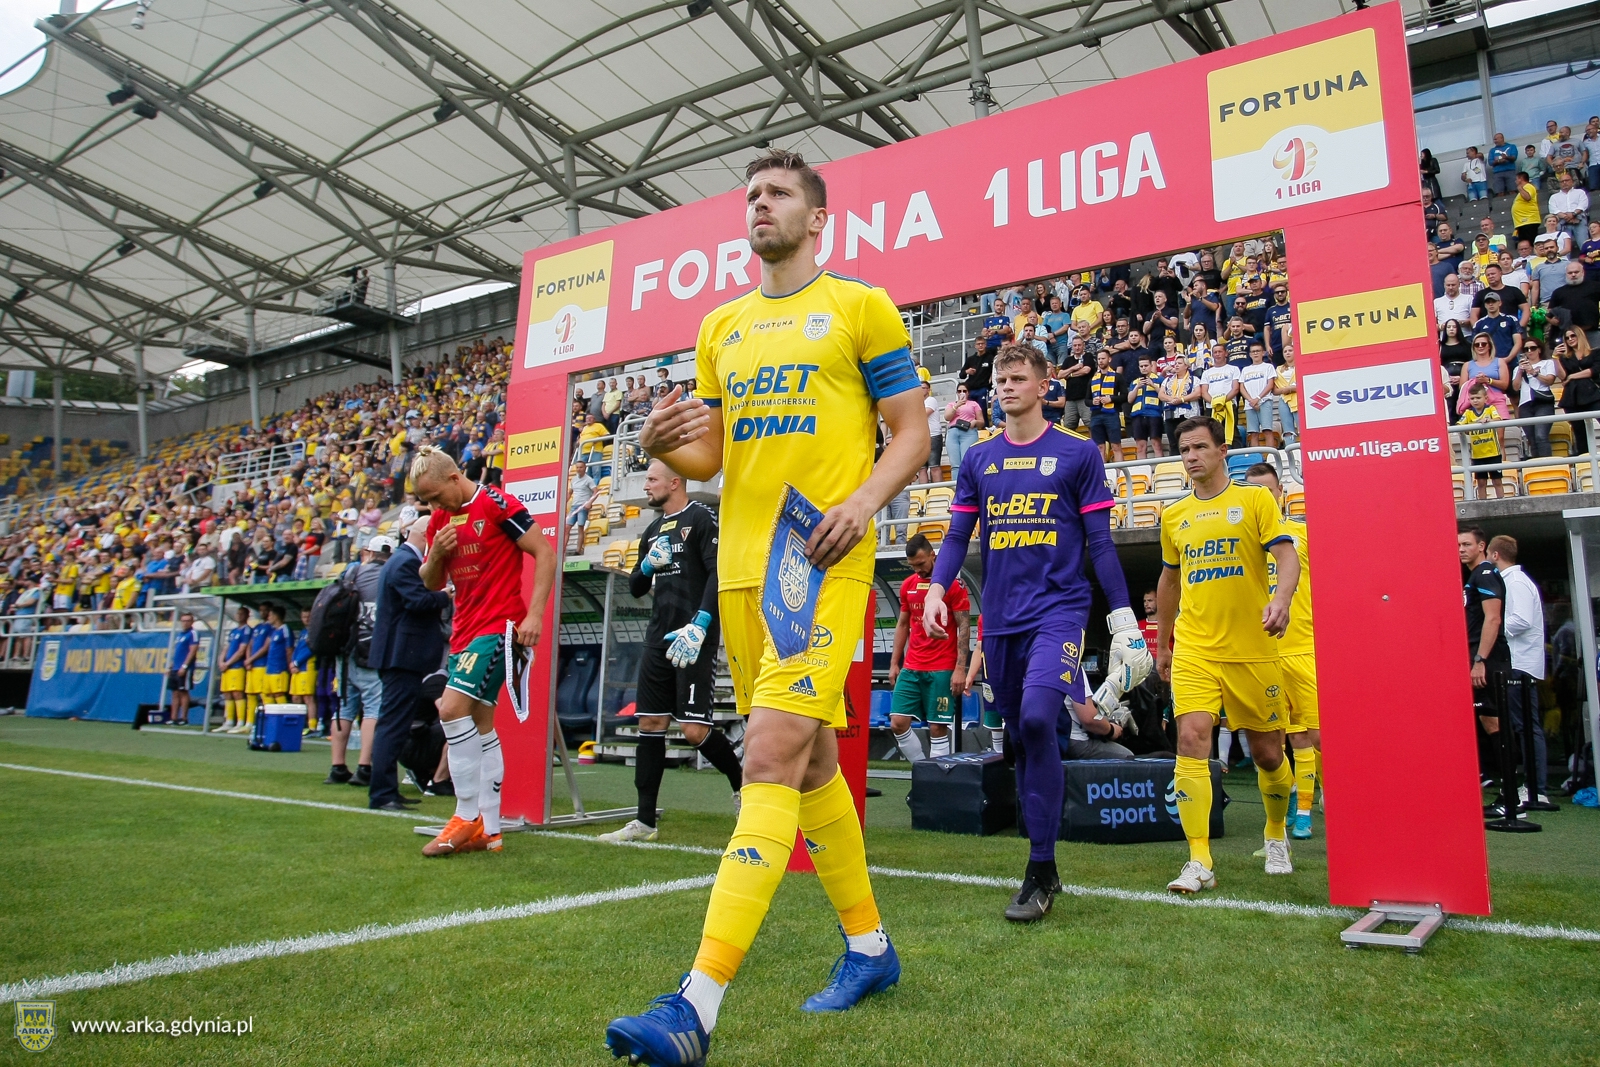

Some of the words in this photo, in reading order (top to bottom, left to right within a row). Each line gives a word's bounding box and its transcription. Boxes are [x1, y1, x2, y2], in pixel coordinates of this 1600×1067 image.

[1219, 70, 1368, 123] FORTUNA
[1275, 188, 1283, 199] 1
[1288, 180, 1321, 197] LIGA
[630, 189, 943, 311] FORUNA
[984, 167, 1009, 228] 1
[1026, 132, 1166, 218] LIGA
[536, 269, 606, 299] FORTUNA
[753, 320, 794, 330] FORTUNA
[1306, 304, 1417, 334] FORTUNA
[558, 344, 575, 355] LIGA
[722, 338, 743, 347] adidas
[726, 364, 820, 399] forBET
[751, 398, 816, 407] BUKMACHERSKIE
[1336, 380, 1429, 405] SUZUKI
[731, 415, 817, 442] DYNIA
[510, 440, 557, 456] FORTUNA
[1307, 437, 1440, 462] www.1liga.org
[517, 490, 556, 503] SUZUKI
[986, 493, 1059, 518] forBET
[989, 531, 1057, 550] GDYNIA
[1184, 538, 1240, 560] forBET
[1188, 566, 1244, 584] GDYNIA
[456, 652, 479, 674] 94
[799, 657, 829, 668] ALDER
[688, 684, 696, 704] 1
[788, 685, 817, 697] adidas
[936, 696, 949, 712] 29
[1086, 778, 1155, 804] polsat
[1100, 803, 1157, 828] sport
